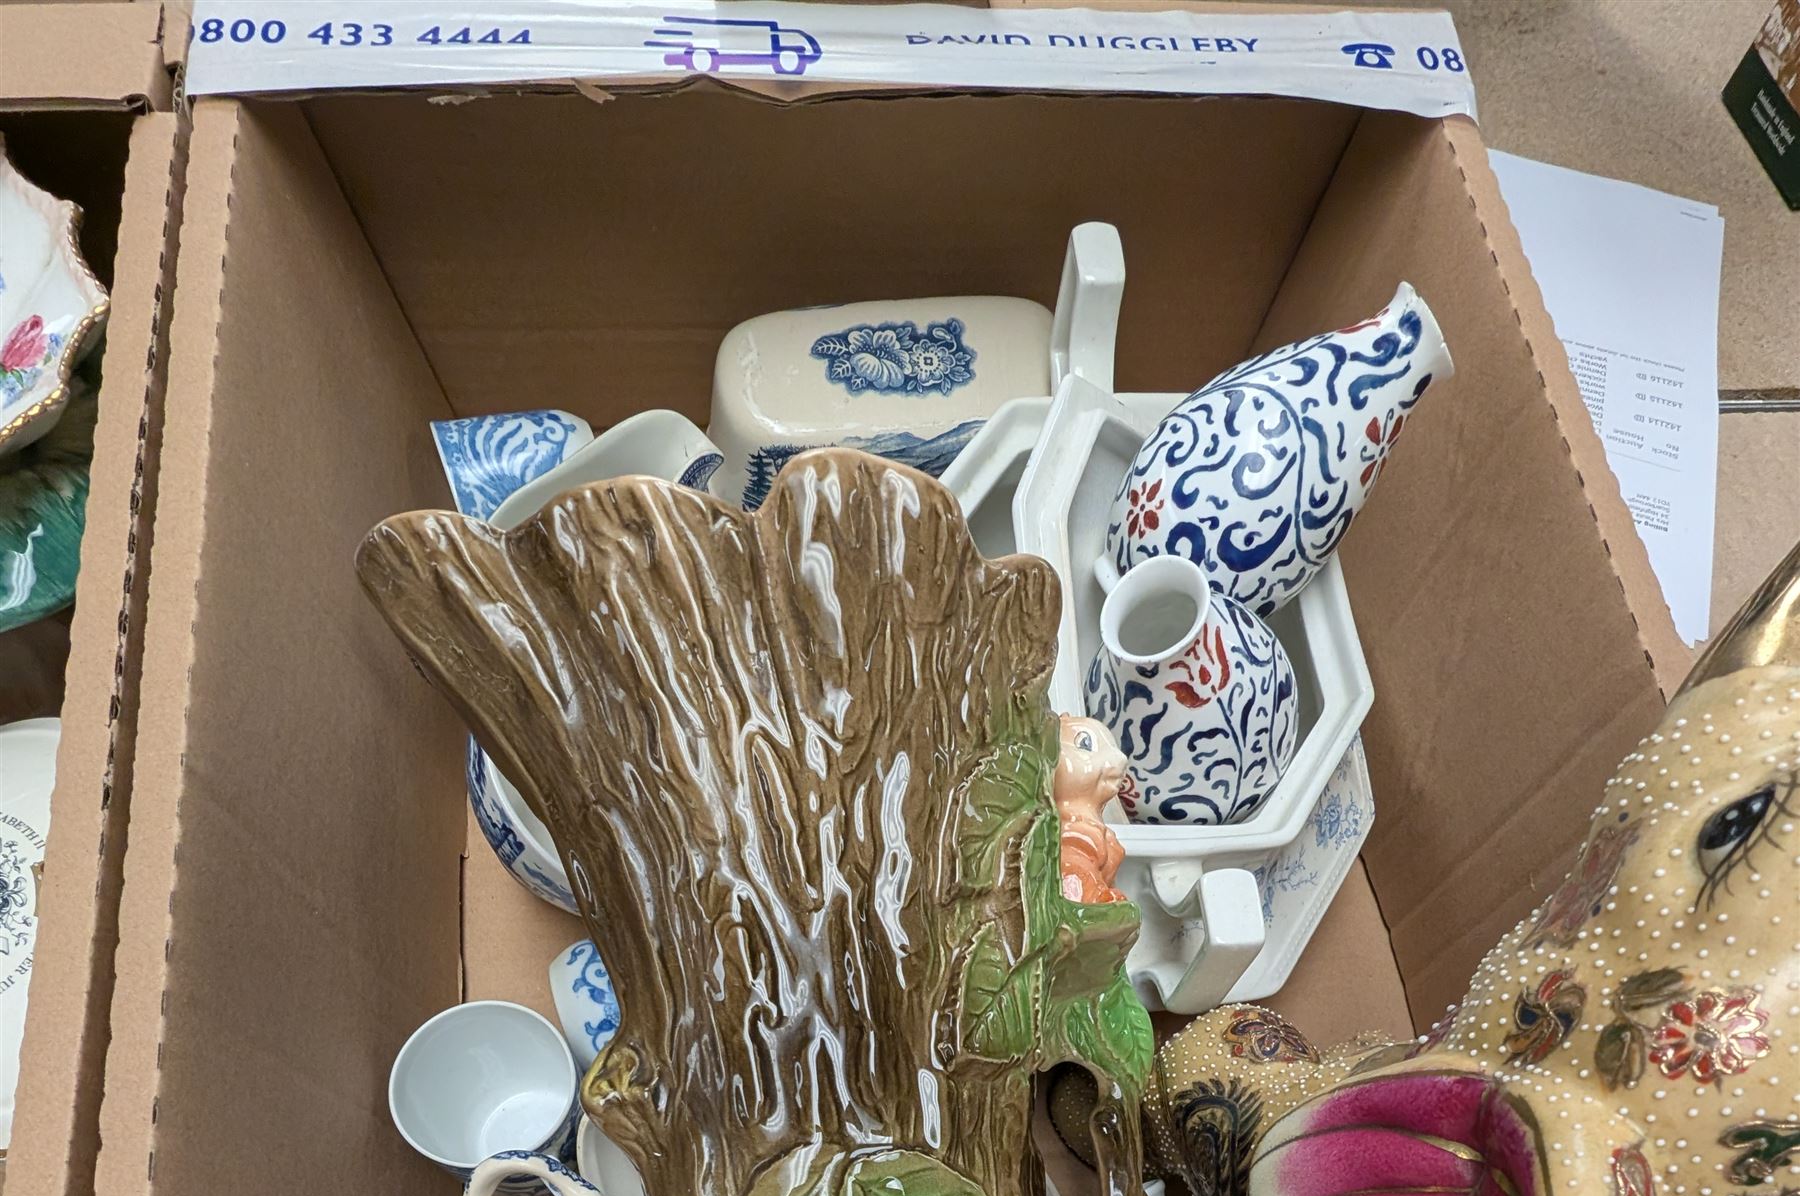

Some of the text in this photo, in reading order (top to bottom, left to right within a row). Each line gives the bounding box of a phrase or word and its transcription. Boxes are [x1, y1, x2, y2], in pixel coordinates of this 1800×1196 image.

[307, 20, 395, 47] 433
[416, 24, 533, 46] 4444
[1417, 45, 1464, 73] 08
[0, 811, 40, 841] ABETH
